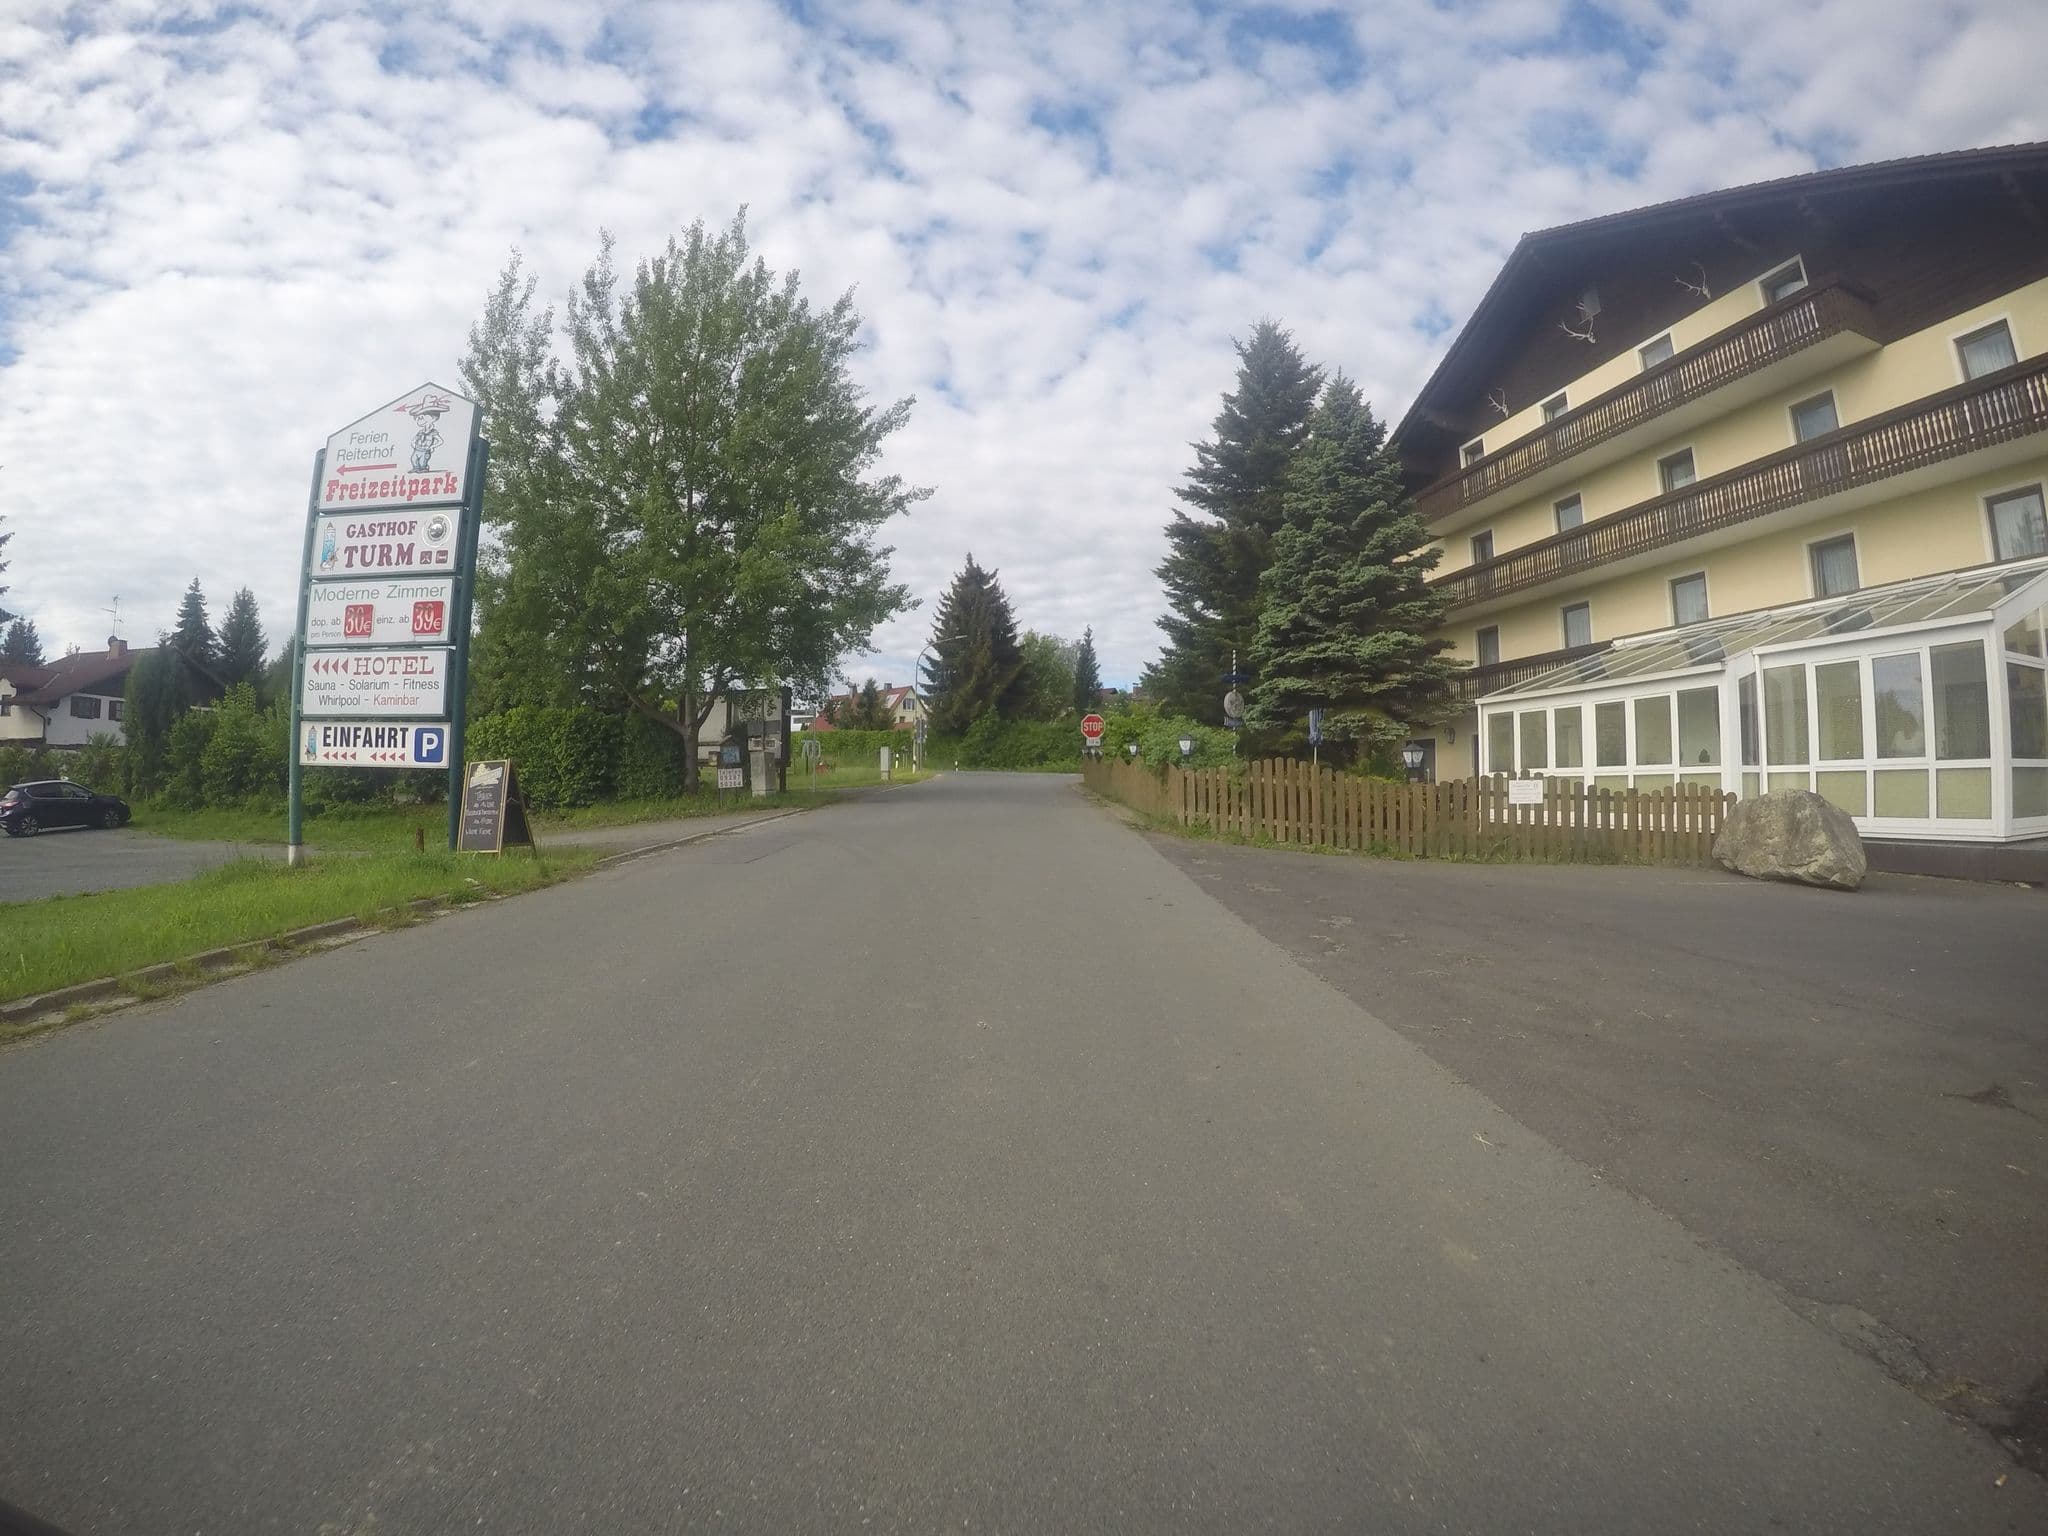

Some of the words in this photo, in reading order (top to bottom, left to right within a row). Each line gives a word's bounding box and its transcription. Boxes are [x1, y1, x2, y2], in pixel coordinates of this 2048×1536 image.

[349, 431, 388, 444] Ferien
[337, 445, 395, 461] Reiterhof
[325, 472, 458, 502] Freizeitpark
[346, 521, 418, 538] GASTHOF
[344, 543, 415, 568] TURM
[313, 588, 380, 601] Moderne
[386, 585, 446, 599] Zimmer
[330, 615, 340, 625] ab
[376, 616, 395, 624] einz.
[399, 614, 409, 623] ab
[353, 656, 434, 675] HOTEL
[307, 680, 336, 690] Sauna
[348, 680, 389, 690] Solarium
[403, 679, 439, 689] Fitness
[319, 694, 361, 707] Whirlpool
[373, 694, 420, 705] Kaminbar
[1084, 722, 1103, 731] STOP
[323, 726, 408, 748] EINFAHRT
[422, 733, 439, 757] P
